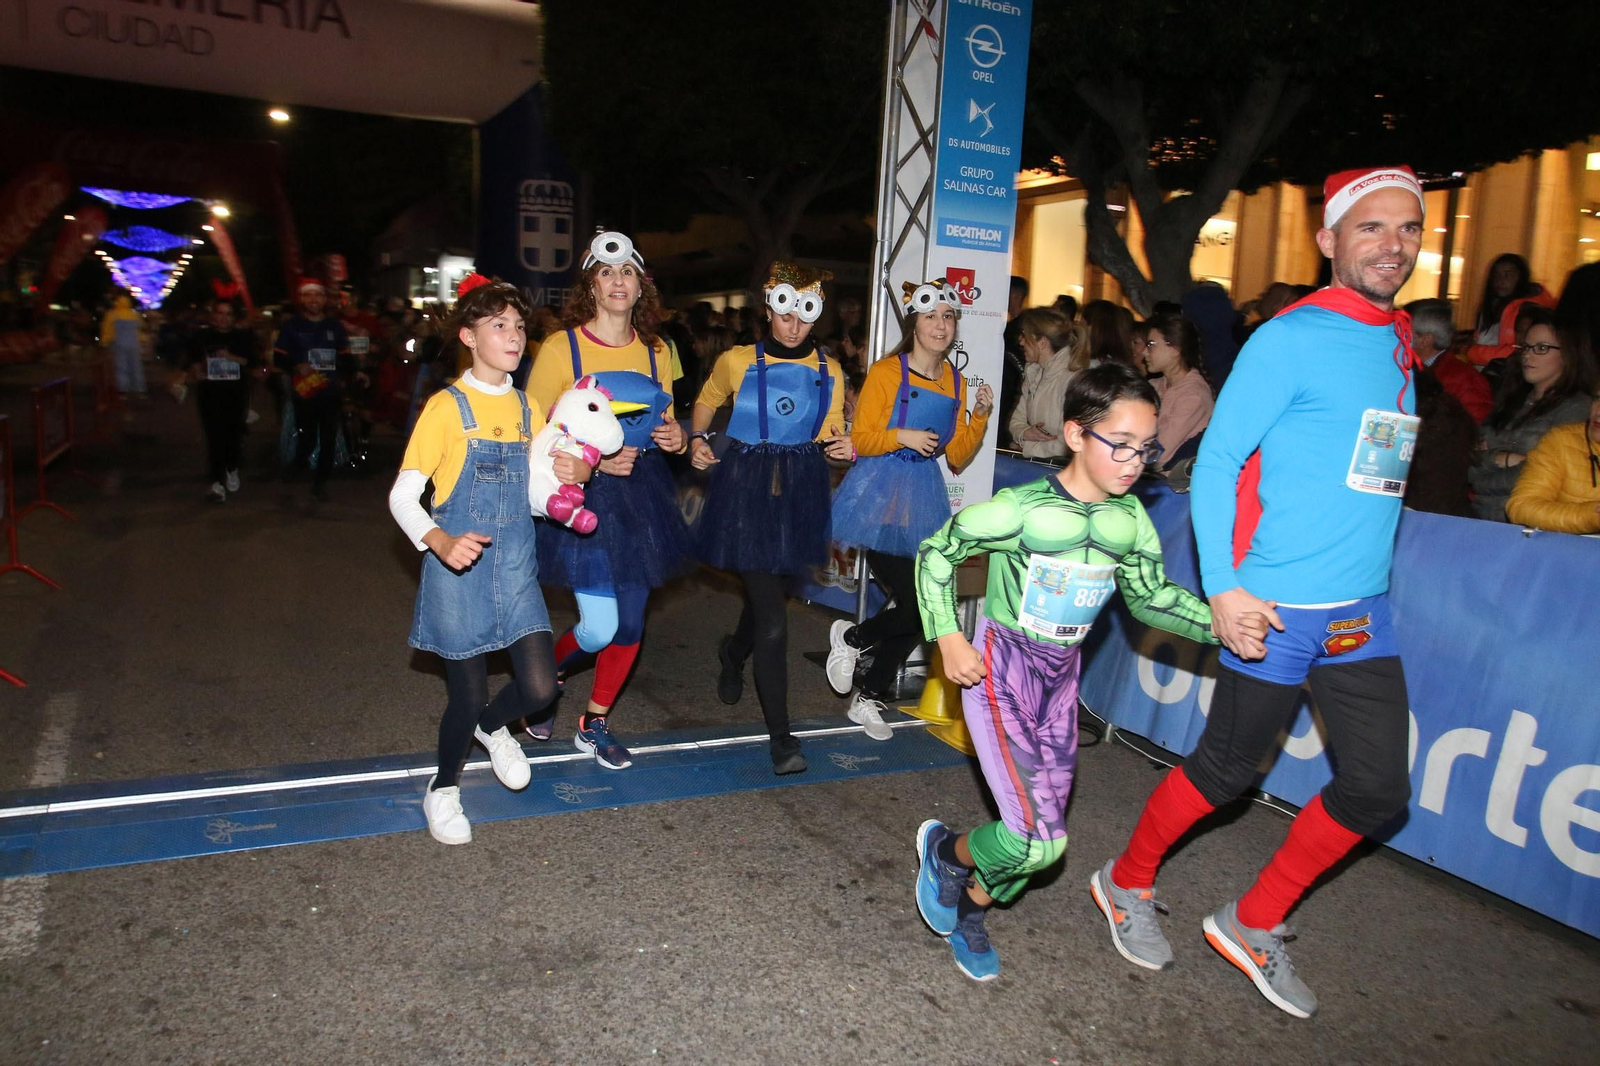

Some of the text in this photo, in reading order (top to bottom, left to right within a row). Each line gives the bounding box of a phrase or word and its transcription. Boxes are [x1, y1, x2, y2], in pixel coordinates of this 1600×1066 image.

[57, 6, 214, 55] CIUDAD
[972, 70, 995, 84] OPEL
[948, 137, 1011, 156] DS AUTOMOBILES
[960, 166, 994, 181] GRUPO
[943, 180, 1007, 198] SALINAS CAR
[1349, 185, 1361, 195] La
[1361, 177, 1379, 188] Voz
[945, 223, 1002, 242] DECATHLON
[1073, 587, 1109, 608] 887
